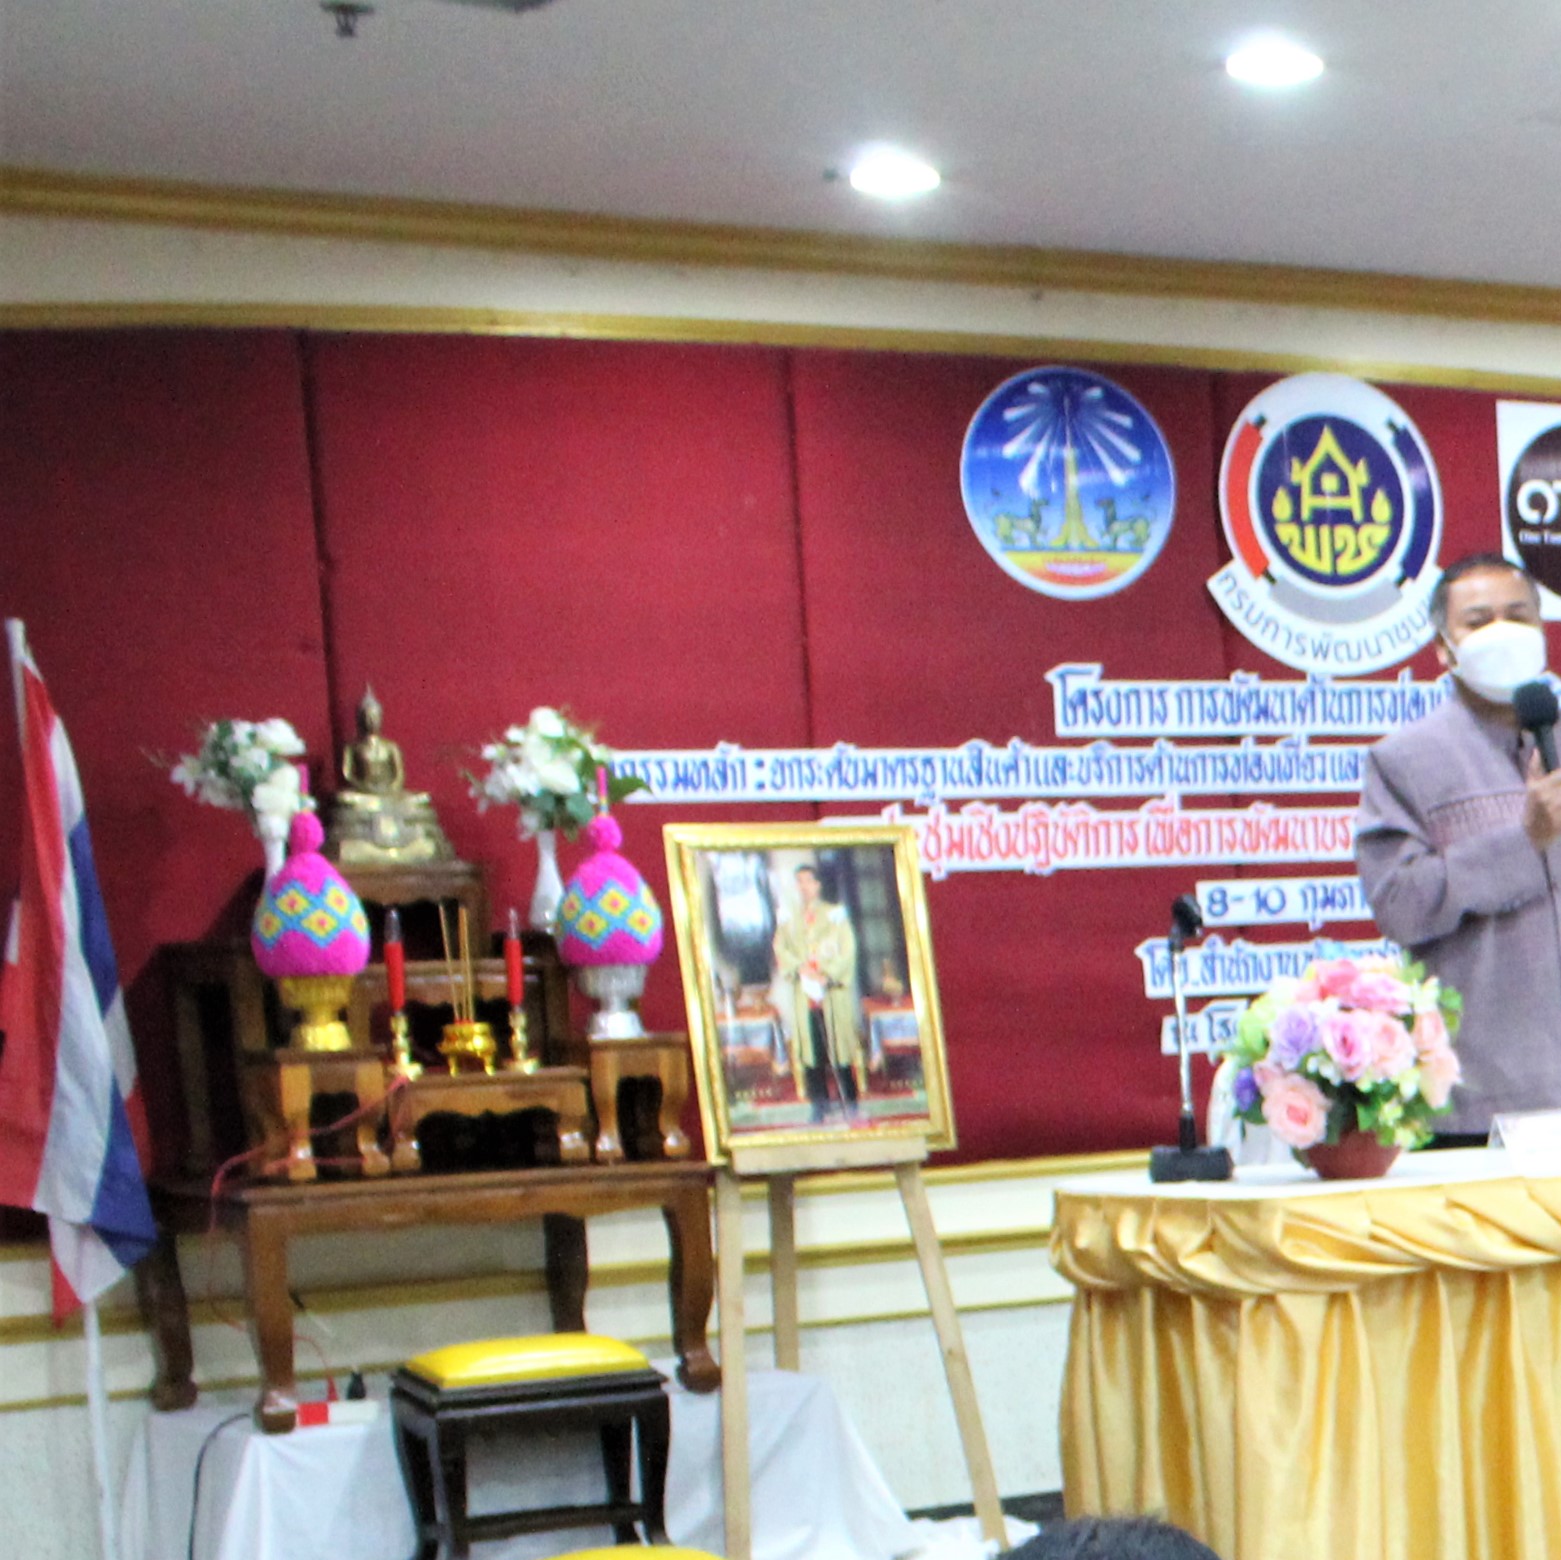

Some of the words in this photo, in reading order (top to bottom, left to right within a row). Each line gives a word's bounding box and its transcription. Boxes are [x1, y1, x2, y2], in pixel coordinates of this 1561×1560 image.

[1217, 570, 1431, 664] กรมการพัฒนาชุม
[609, 744, 748, 791] กรรมหลัก
[1206, 887, 1287, 917] 8-10
